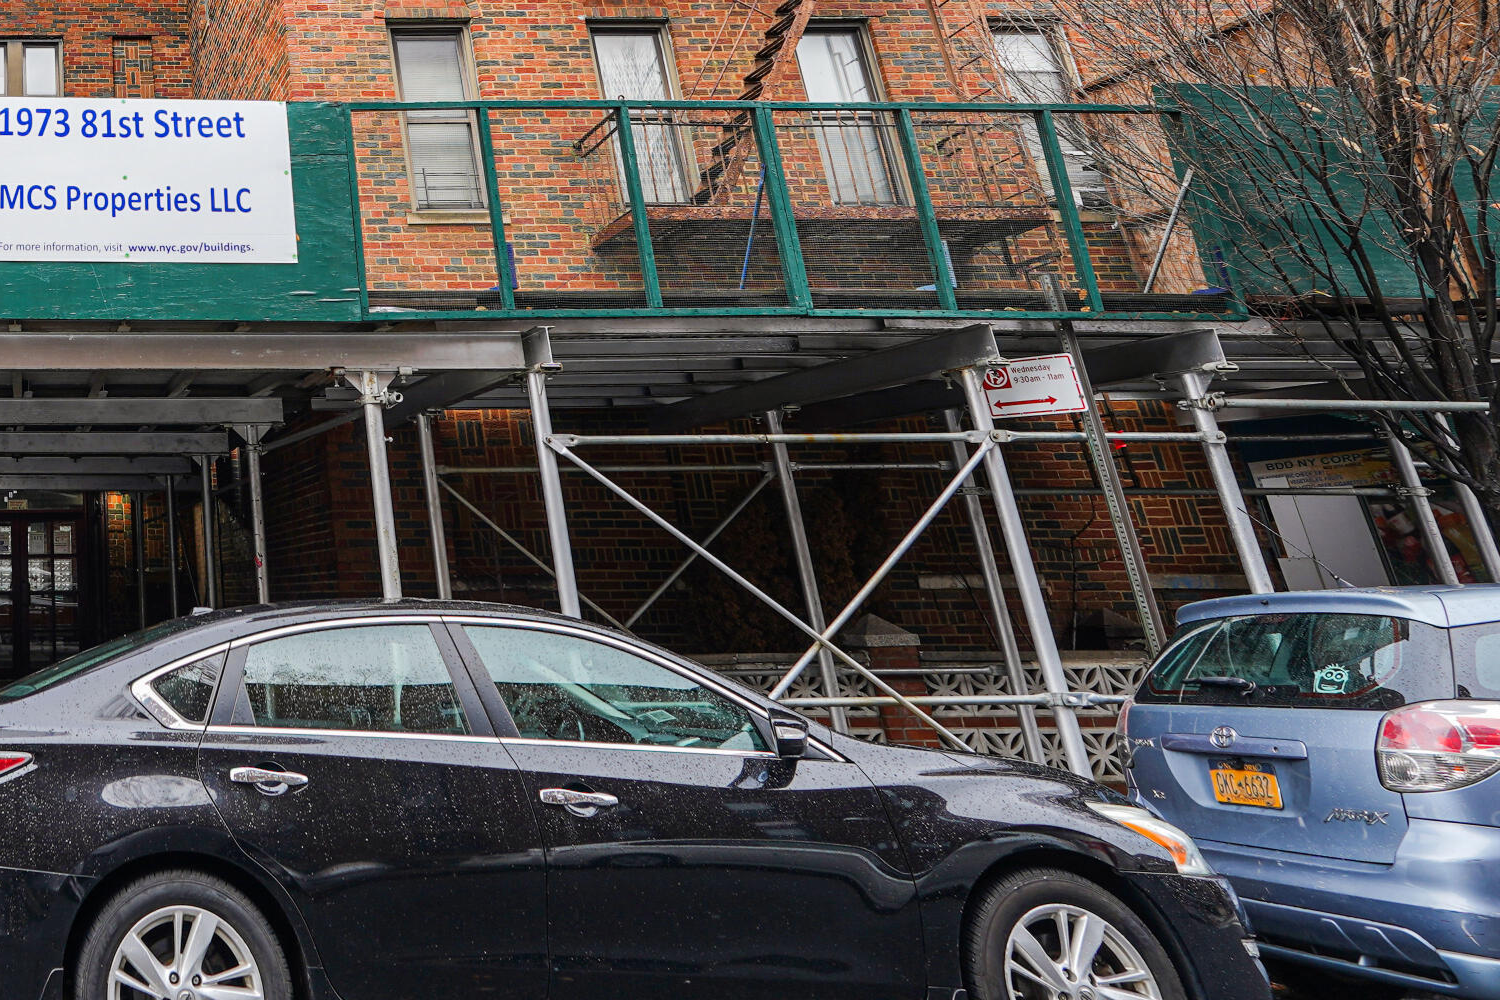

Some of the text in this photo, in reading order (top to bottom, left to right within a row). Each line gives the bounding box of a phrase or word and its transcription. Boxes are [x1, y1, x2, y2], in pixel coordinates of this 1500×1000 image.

[81, 109, 144, 138] 81st
[154, 109, 246, 138] Street
[0, 184, 252, 217] MCS Properties LLC
[15, 244, 40, 252] more
[43, 242, 101, 253] information,
[104, 242, 123, 252] visit
[128, 241, 255, 254] www.nyc.gov/buildings.
[1011, 364, 1051, 374] Wednesday
[1013, 375, 1042, 384] 9:30am
[1298, 457, 1316, 468] NY
[1321, 453, 1360, 465] CORP
[1244, 775, 1273, 798] 6632
